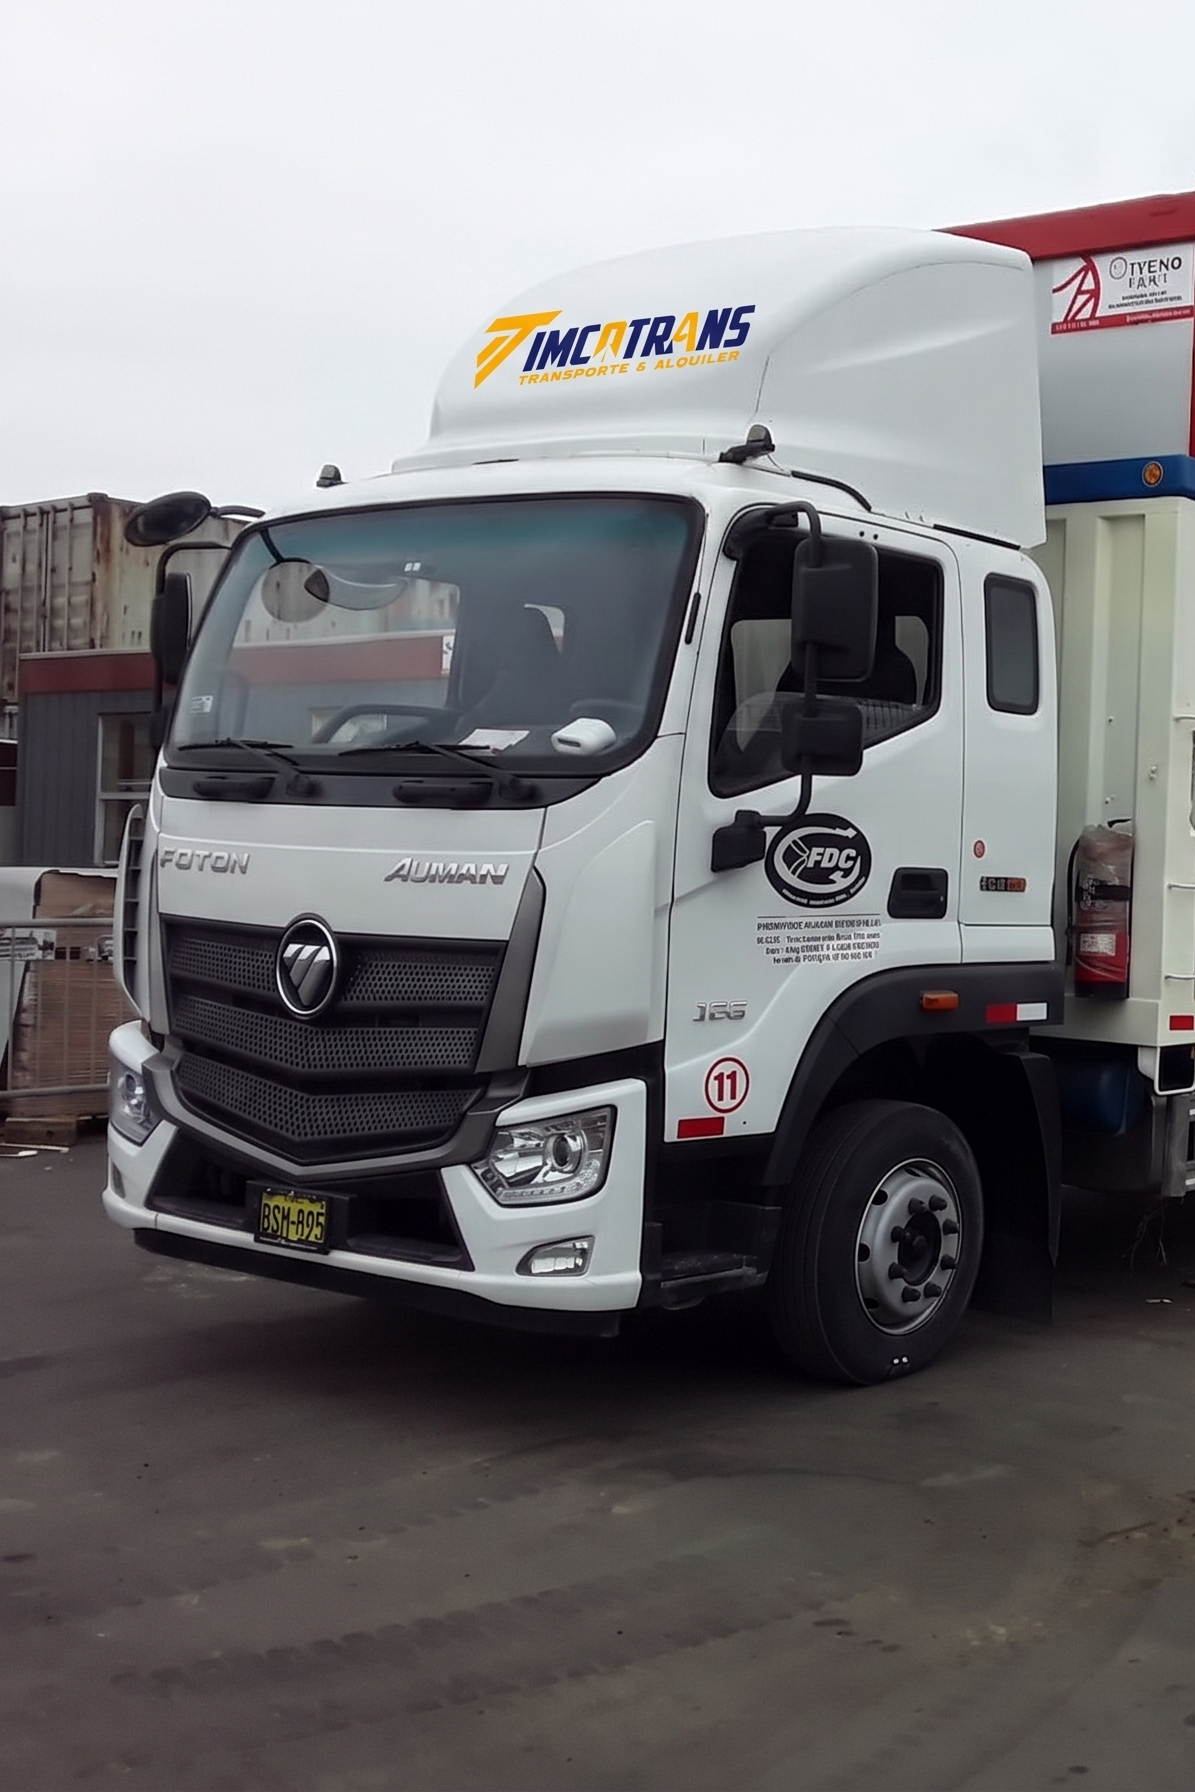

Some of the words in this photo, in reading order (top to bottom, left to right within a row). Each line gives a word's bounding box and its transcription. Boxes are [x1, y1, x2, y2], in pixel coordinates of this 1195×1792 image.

[518, 362, 629, 386] TRANSPORTE
[635, 361, 647, 373] &
[653, 350, 741, 371] ALQUILER
[160, 848, 251, 875] FOTON
[384, 857, 509, 885] AUMAN
[806, 847, 858, 869] FDC
[713, 1069, 738, 1102] 11
